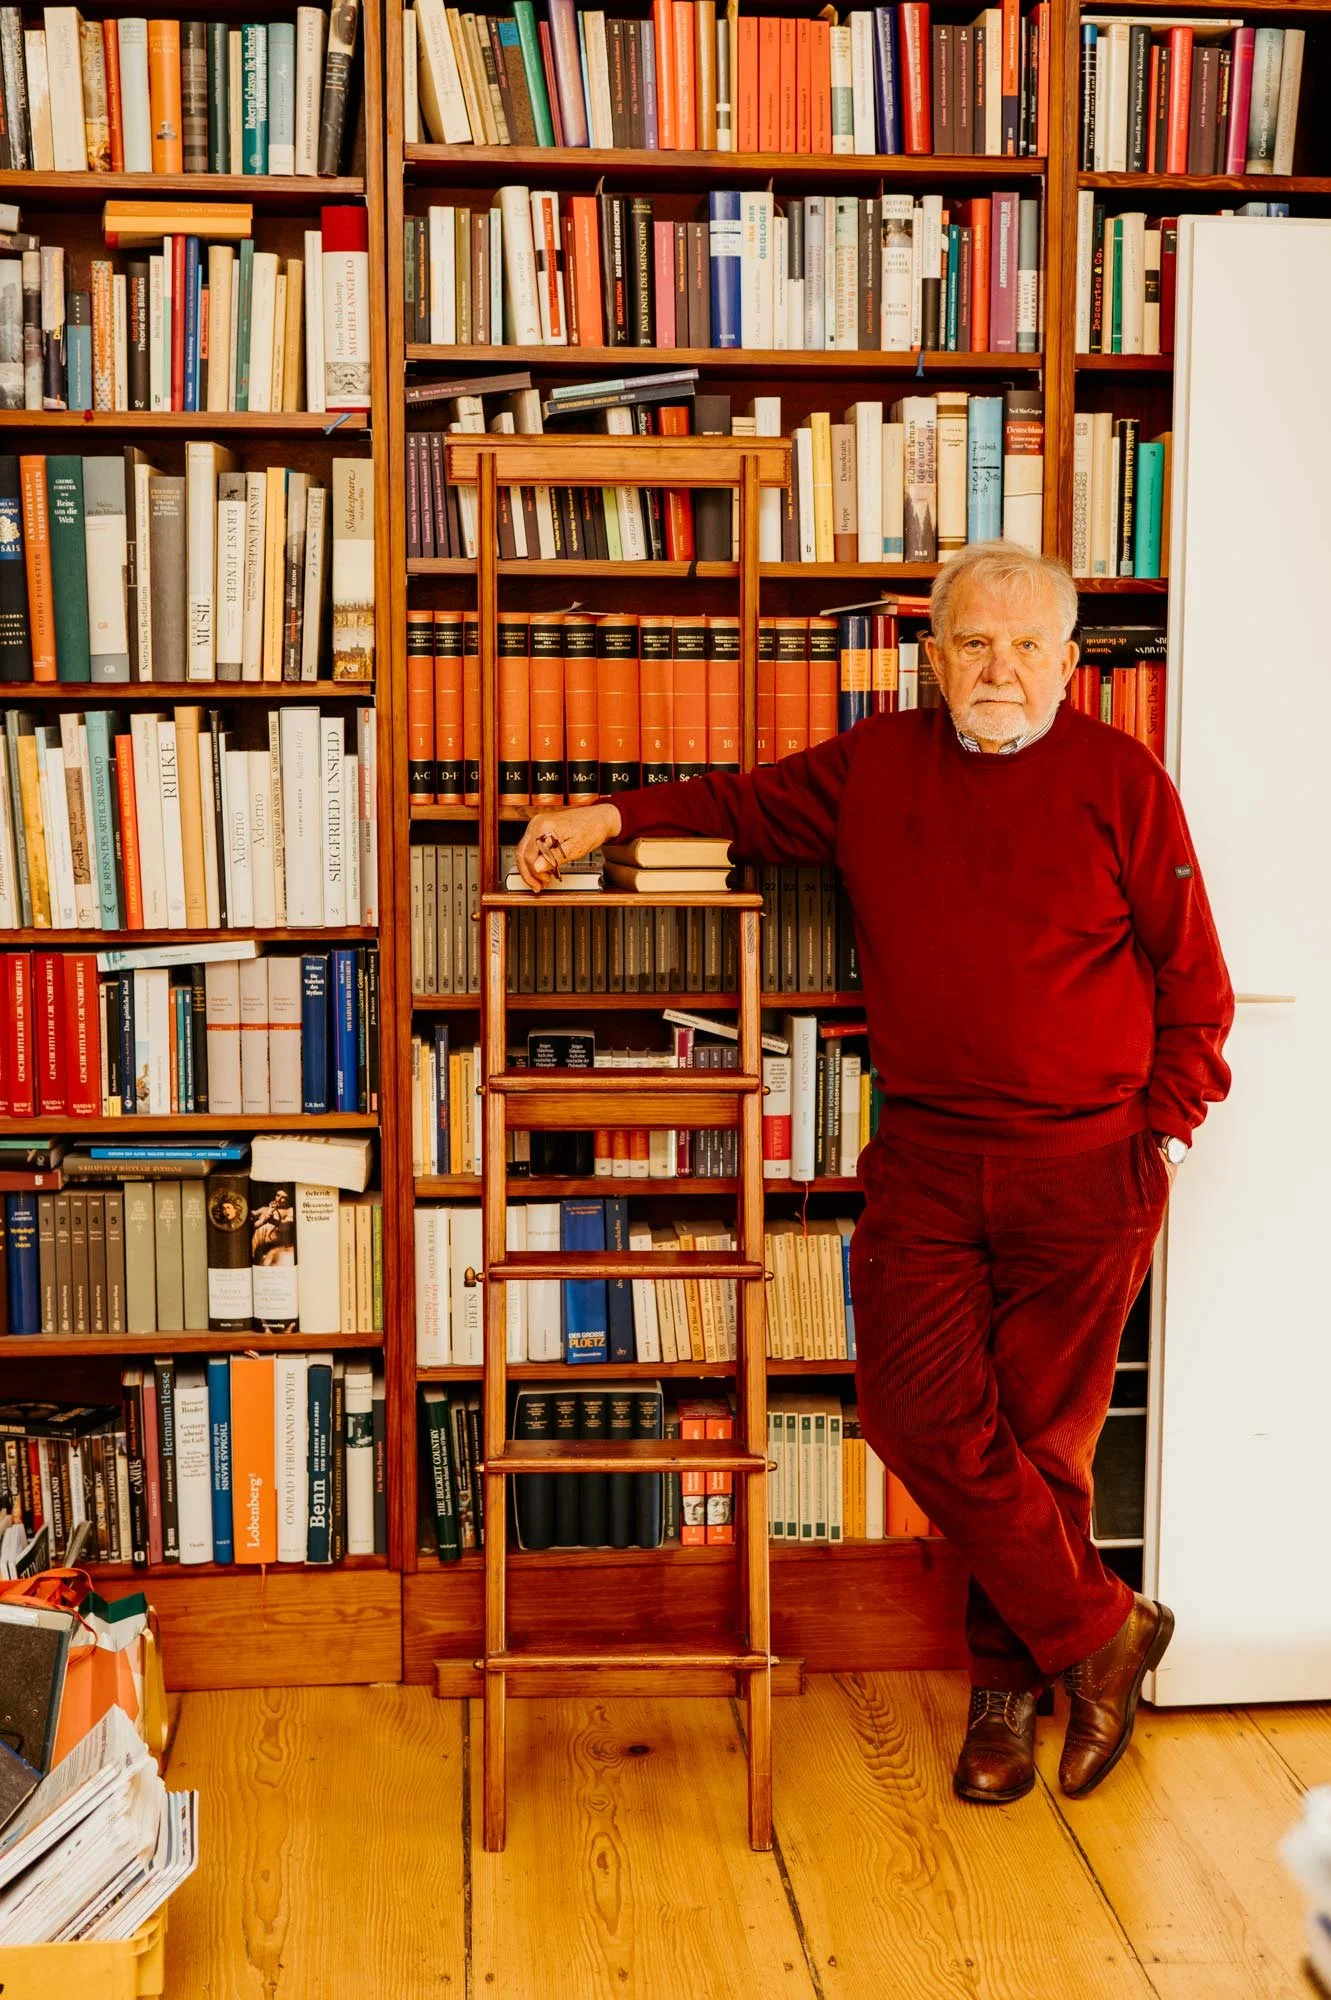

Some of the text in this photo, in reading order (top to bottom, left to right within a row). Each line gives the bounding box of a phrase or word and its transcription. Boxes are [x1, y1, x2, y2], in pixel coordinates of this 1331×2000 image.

[245, 28, 255, 57] Hochzeit
[245, 59, 256, 70] Die
[245, 101, 256, 128] Roberto
[1136, 80, 1144, 112] Philosophie
[1258, 131, 1267, 157] Charles
[613, 200, 621, 236] GESCHICHTE
[758, 205, 767, 259] ÖKOLOGIE
[639, 222, 647, 273] MENSCHEN
[847, 245, 856, 287] Zygmunt
[131, 278, 139, 319] Bredekamp
[345, 260, 358, 355] MICHELANGELO
[1092, 247, 1103, 330] Descartes & Co.
[138, 324, 146, 352] Theorie
[334, 282, 344, 355] Horst Bredekamp
[907, 420, 916, 484] Richard Tarnas
[917, 441, 926, 484] Idee und
[926, 420, 935, 484] Leidenschaft
[35, 471, 45, 540] NIEDERRHEIN
[250, 487, 259, 523] ERNST
[345, 470, 356, 532] Shakespeare
[840, 439, 850, 531] Hoppe Demokratie
[26, 484, 35, 540] ANSICHTEN
[59, 516, 74, 524] Welt
[67, 507, 77, 515] die
[226, 509, 237, 602] ERNST JÜNGER
[36, 602, 44, 635] GEORG
[141, 586, 149, 670] Nietzsches Bestiarium
[197, 598, 210, 647] MUSIL
[1148, 685, 1158, 734] Sartre Das
[580, 739, 586, 748] 6
[655, 740, 661, 748] 8
[689, 740, 695, 748] 9
[723, 740, 733, 748] 10
[788, 740, 797, 748] 12
[161, 741, 177, 799] RILKE
[413, 772, 430, 780] A-C
[506, 772, 522, 780] I-K
[612, 773, 629, 782] P-Q
[648, 774, 668, 782] R-Sc
[95, 756, 112, 895] DIE REISEN DES ARTHUR RIMBAUD
[253, 794, 265, 847] Adorno
[327, 731, 341, 882] SIEGFRIED UNSELD
[72, 840, 91, 878] Goethe
[233, 812, 246, 867] Adorno
[427, 883, 433, 891] 2
[442, 884, 448, 892] 3
[457, 883, 463, 891] 4
[472, 883, 478, 892] 5
[468, 1294, 478, 1328] IDEEN
[569, 1338, 605, 1348] PLOETZ
[162, 1372, 173, 1456] Hermann Hesse
[220, 1423, 229, 1490] THOMAS MANN
[285, 1372, 296, 1525] CONRAD FERDINAND MEYER
[134, 1459, 143, 1494] CAMUS
[430, 1429, 446, 1516] THE BECKETT COUNTRY
[31, 1475, 42, 1516] MACBETH
[52, 1477, 62, 1537] GELOBTES LAND
[311, 1480, 325, 1528] Benn
